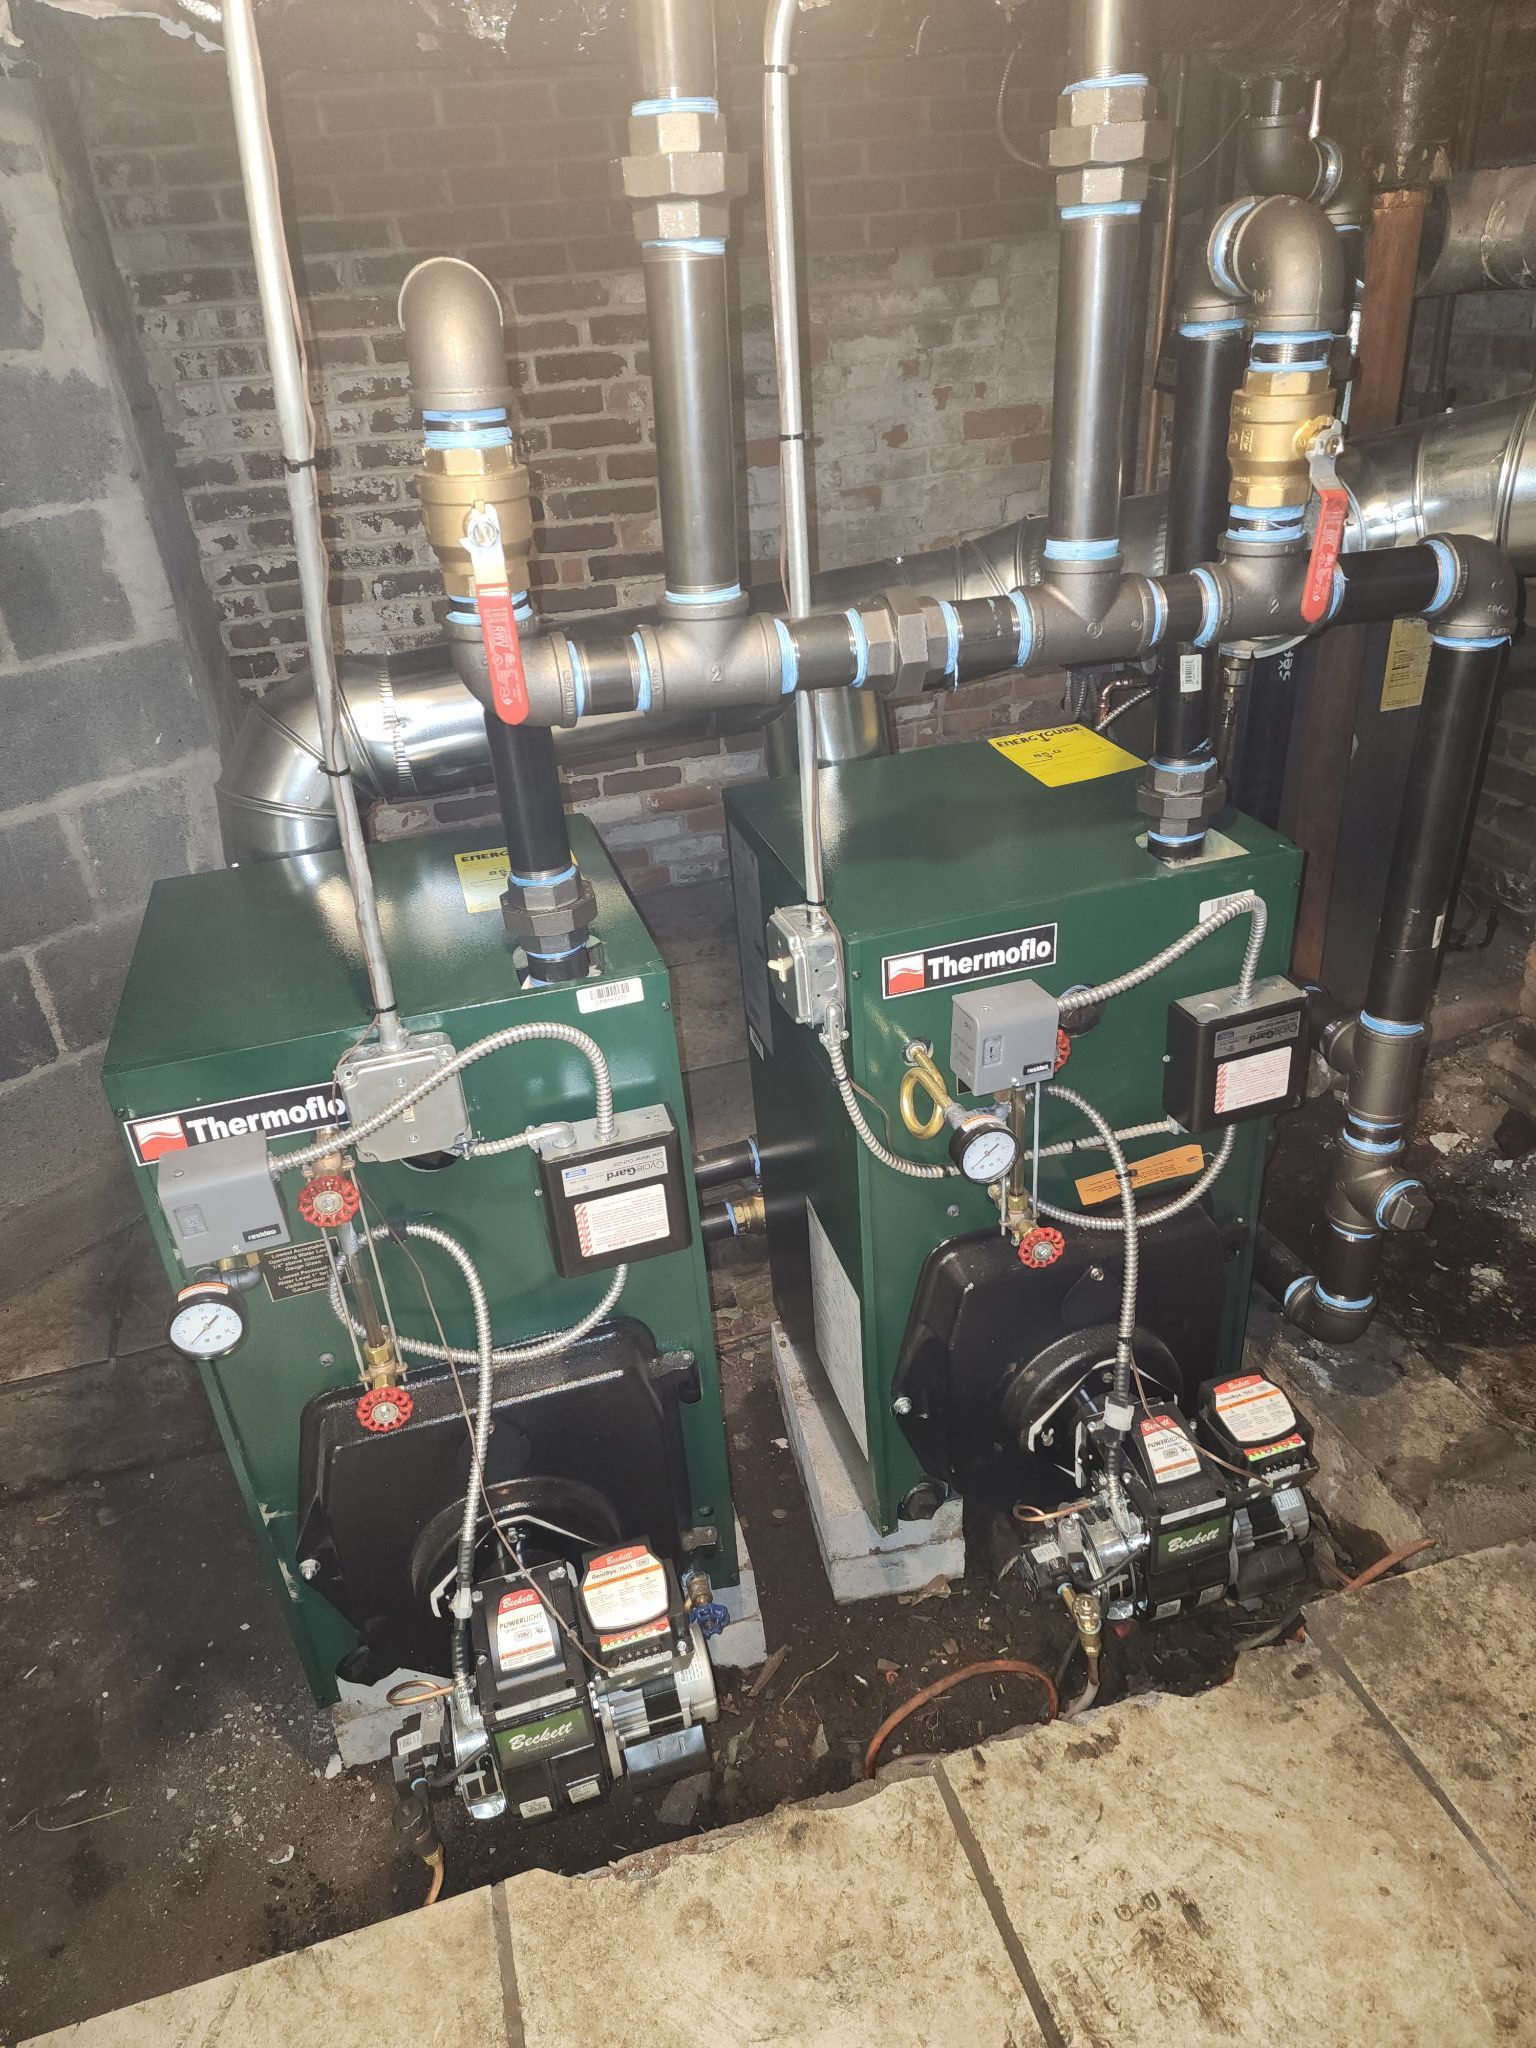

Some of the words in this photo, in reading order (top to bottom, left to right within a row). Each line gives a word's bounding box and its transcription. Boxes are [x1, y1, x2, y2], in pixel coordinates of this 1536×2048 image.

[493, 625, 507, 647] RWV
[711, 665, 722, 682] 2
[928, 937, 1052, 980] Thermoflo
[186, 1095, 346, 1144] Thermoflo
[605, 1160, 665, 1181] CycleGard
[268, 1254, 297, 1265] Operating
[298, 1250, 315, 1258] Water
[271, 1250, 293, 1259] Lowest
[284, 1263, 304, 1272] Gauge
[1167, 1527, 1220, 1552] Beckett
[501, 1592, 535, 1609] Beckett
[499, 1611, 543, 1630] POWERLIGHT
[508, 1721, 573, 1751] Beckett
